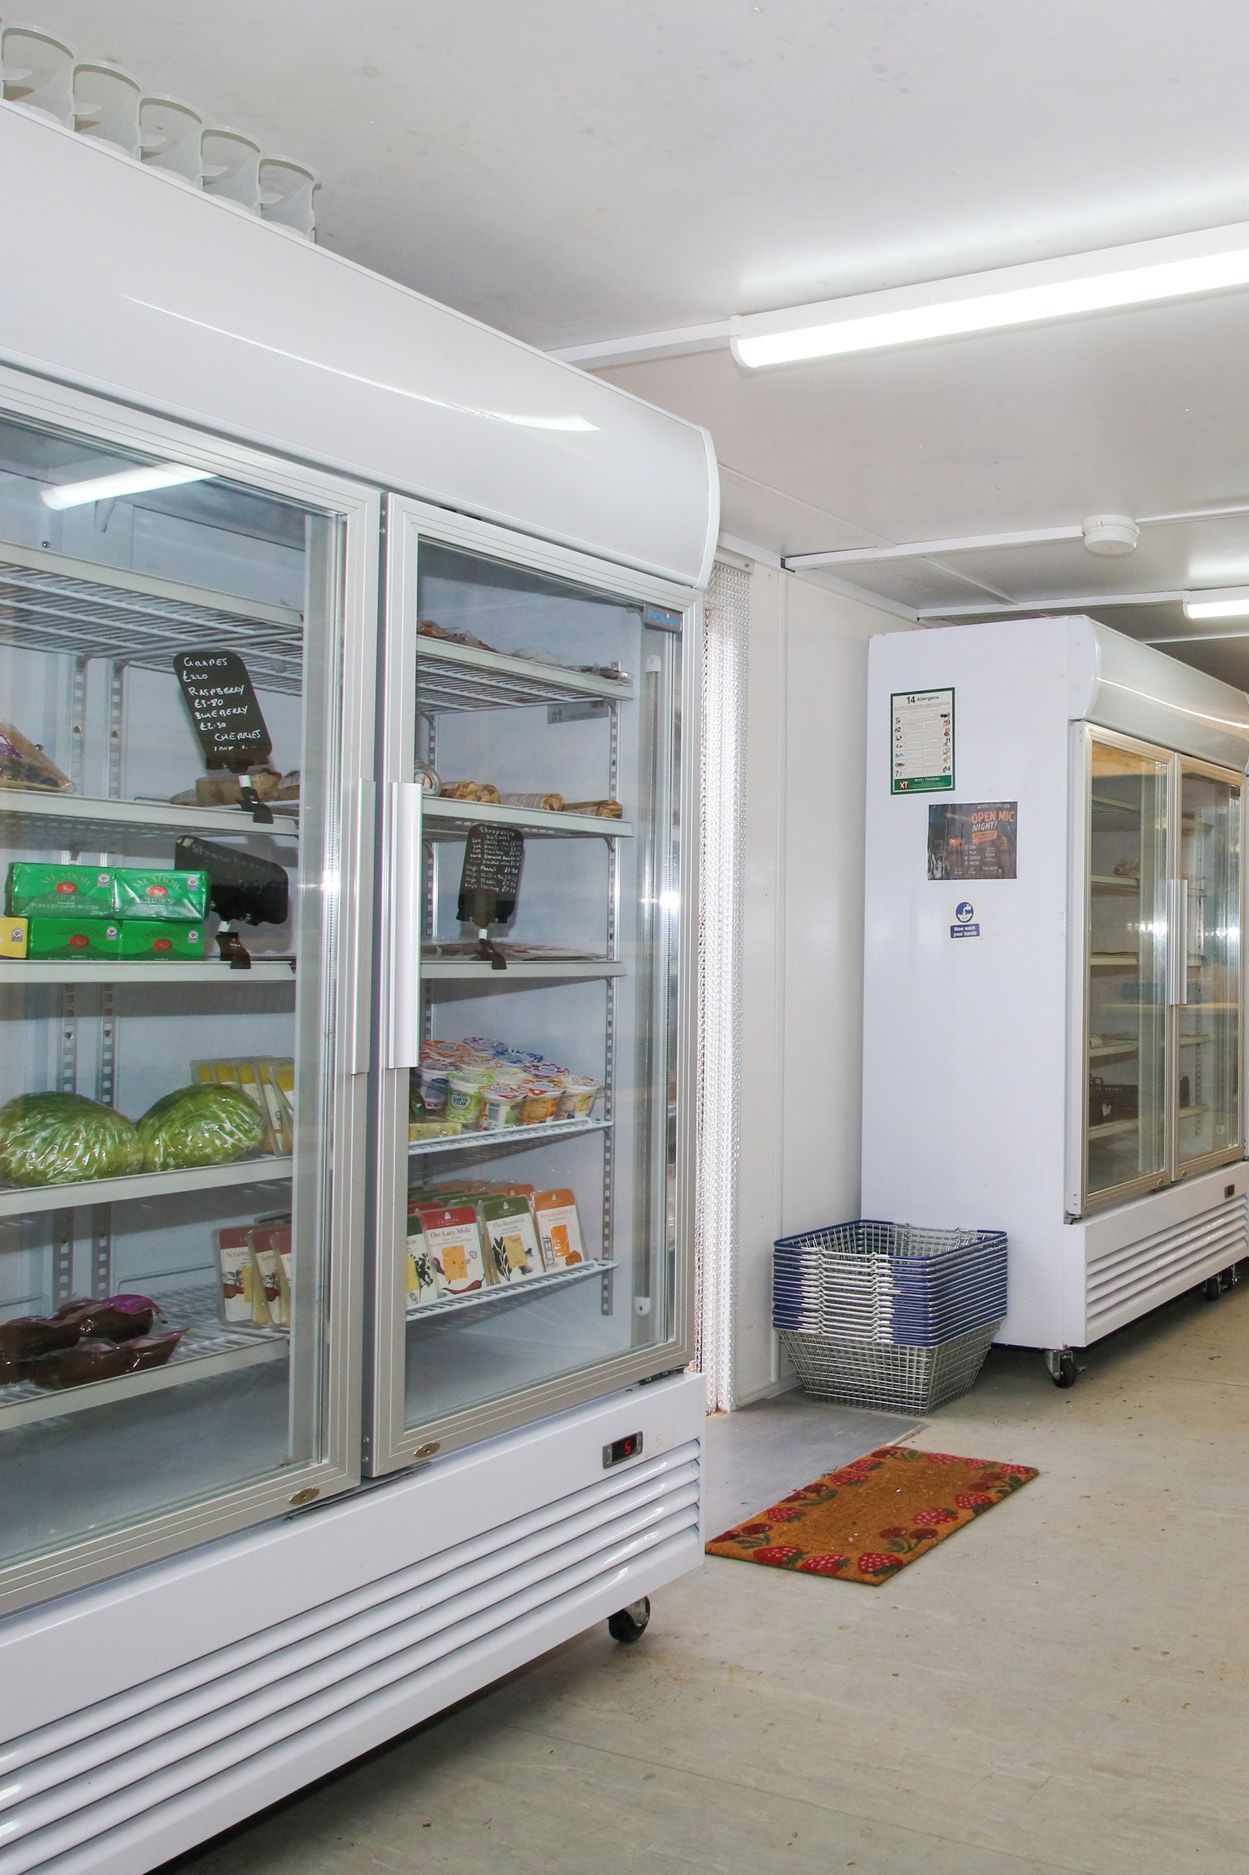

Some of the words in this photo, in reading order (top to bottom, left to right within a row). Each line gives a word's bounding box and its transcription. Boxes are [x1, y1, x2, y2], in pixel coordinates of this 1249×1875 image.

[184, 657, 227, 667] GRAPES
[188, 684, 245, 696] RASPBERRY
[907, 696, 915, 704] 14
[971, 811, 996, 823] OPEN
[998, 810, 1015, 822] MIC
[972, 821, 997, 832] NIGHT!
